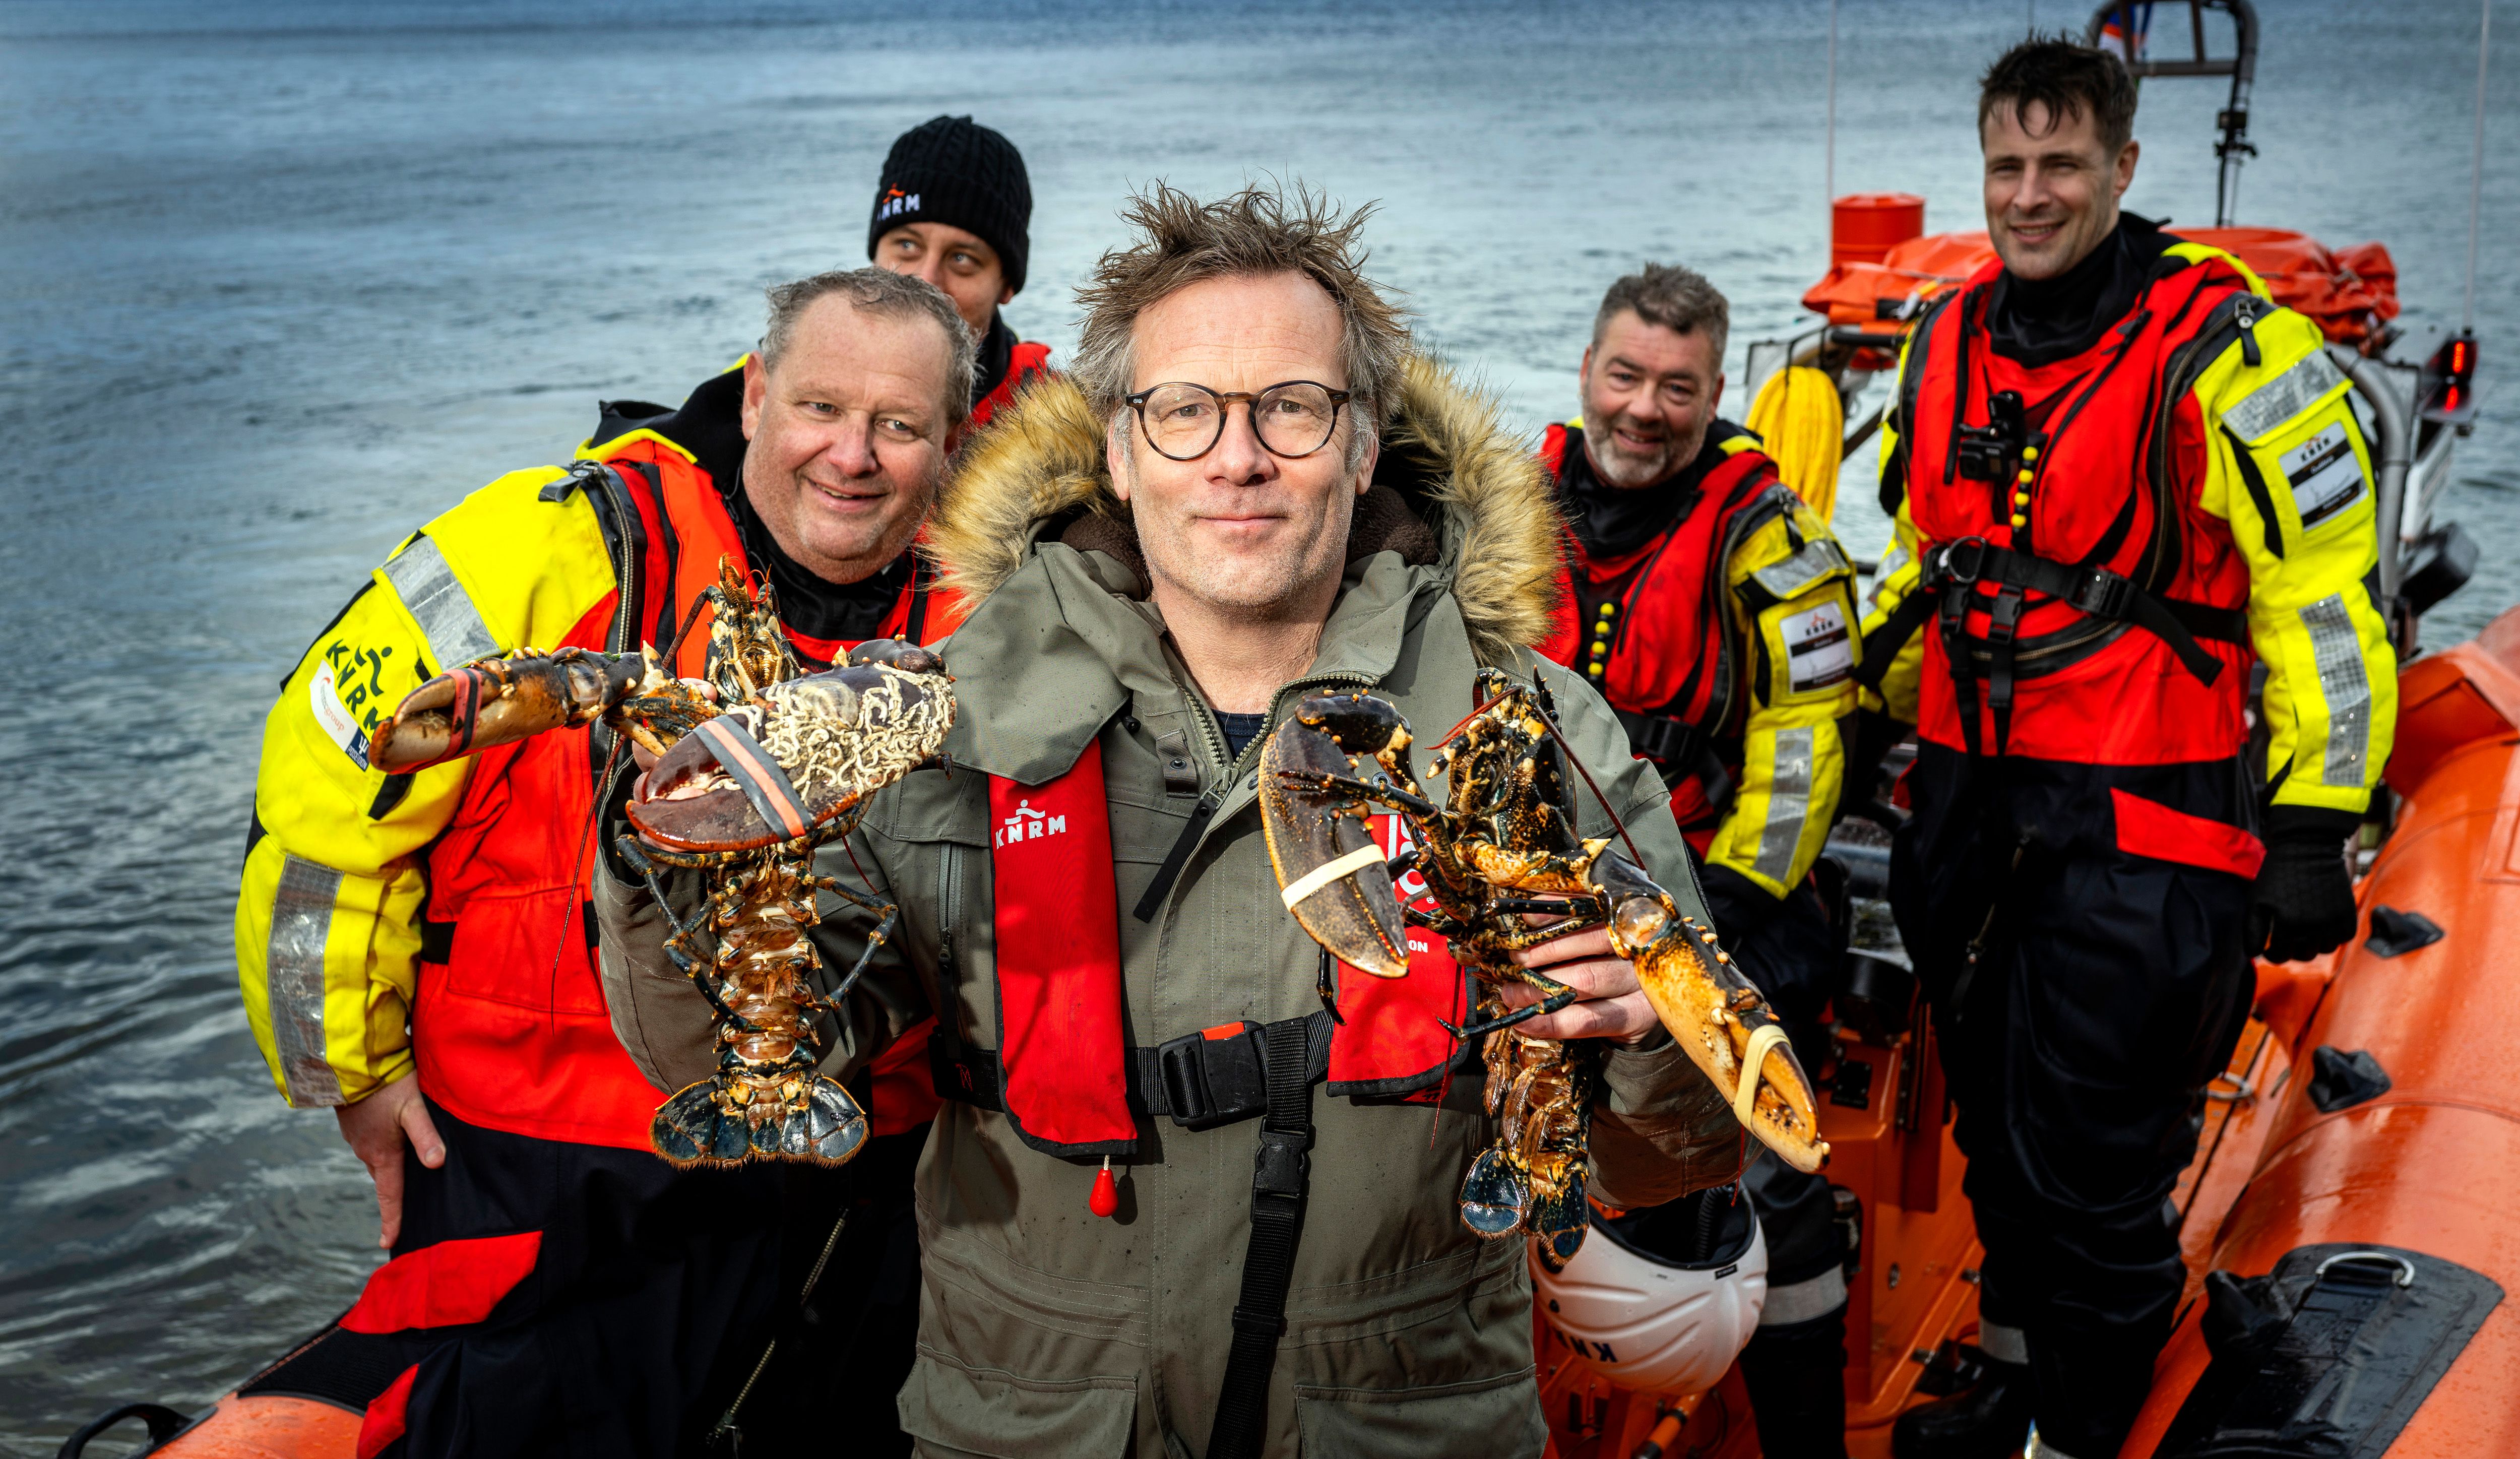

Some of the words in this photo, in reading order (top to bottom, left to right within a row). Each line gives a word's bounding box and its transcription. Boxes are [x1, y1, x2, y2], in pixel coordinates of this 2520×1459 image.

[346, 745, 368, 771] POSEIDON
[995, 814, 1066, 850] KNRM
[1407, 939, 1428, 954] ON
